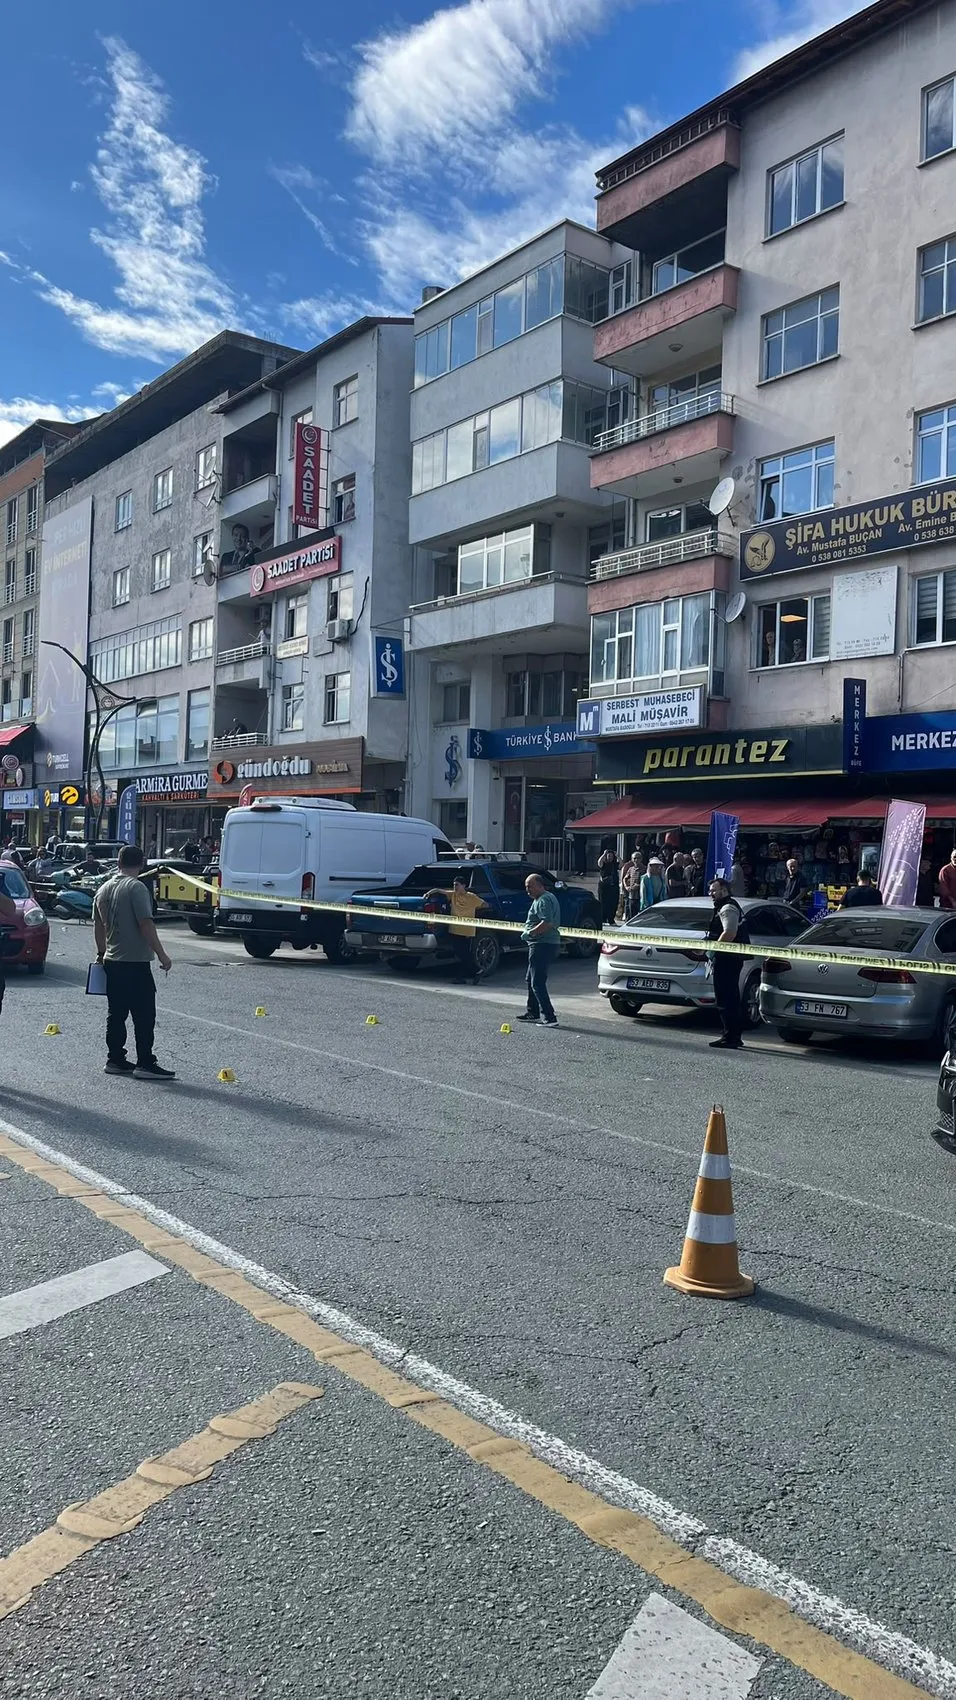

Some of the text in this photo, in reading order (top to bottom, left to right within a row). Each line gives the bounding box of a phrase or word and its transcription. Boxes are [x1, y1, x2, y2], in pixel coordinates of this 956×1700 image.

[302, 446, 315, 514] SAADET
[785, 521, 825, 550] ŞİFA
[831, 502, 904, 536] HUKUK
[898, 523, 913, 533] Av.
[915, 516, 947, 529] Emine
[914, 525, 955, 541] 0 538 638
[796, 528, 883, 555] Av. Mustafa BUÇAN
[818, 551, 831, 561] 538
[832, 549, 846, 558] 081
[848, 545, 867, 555] 5353
[267, 555, 299, 579] SAADET
[606, 689, 695, 711] SERBEST MUHASEBECİ
[612, 704, 688, 724] MALİ MÜŞAVİR
[853, 685, 861, 756] MERKEZ
[505, 733, 543, 747] TÜRKİYE
[237, 755, 311, 778] gündoğdu
[642, 738, 789, 774] parantez
[172, 773, 208, 792] GURME
[831, 1005, 845, 1014] 767
